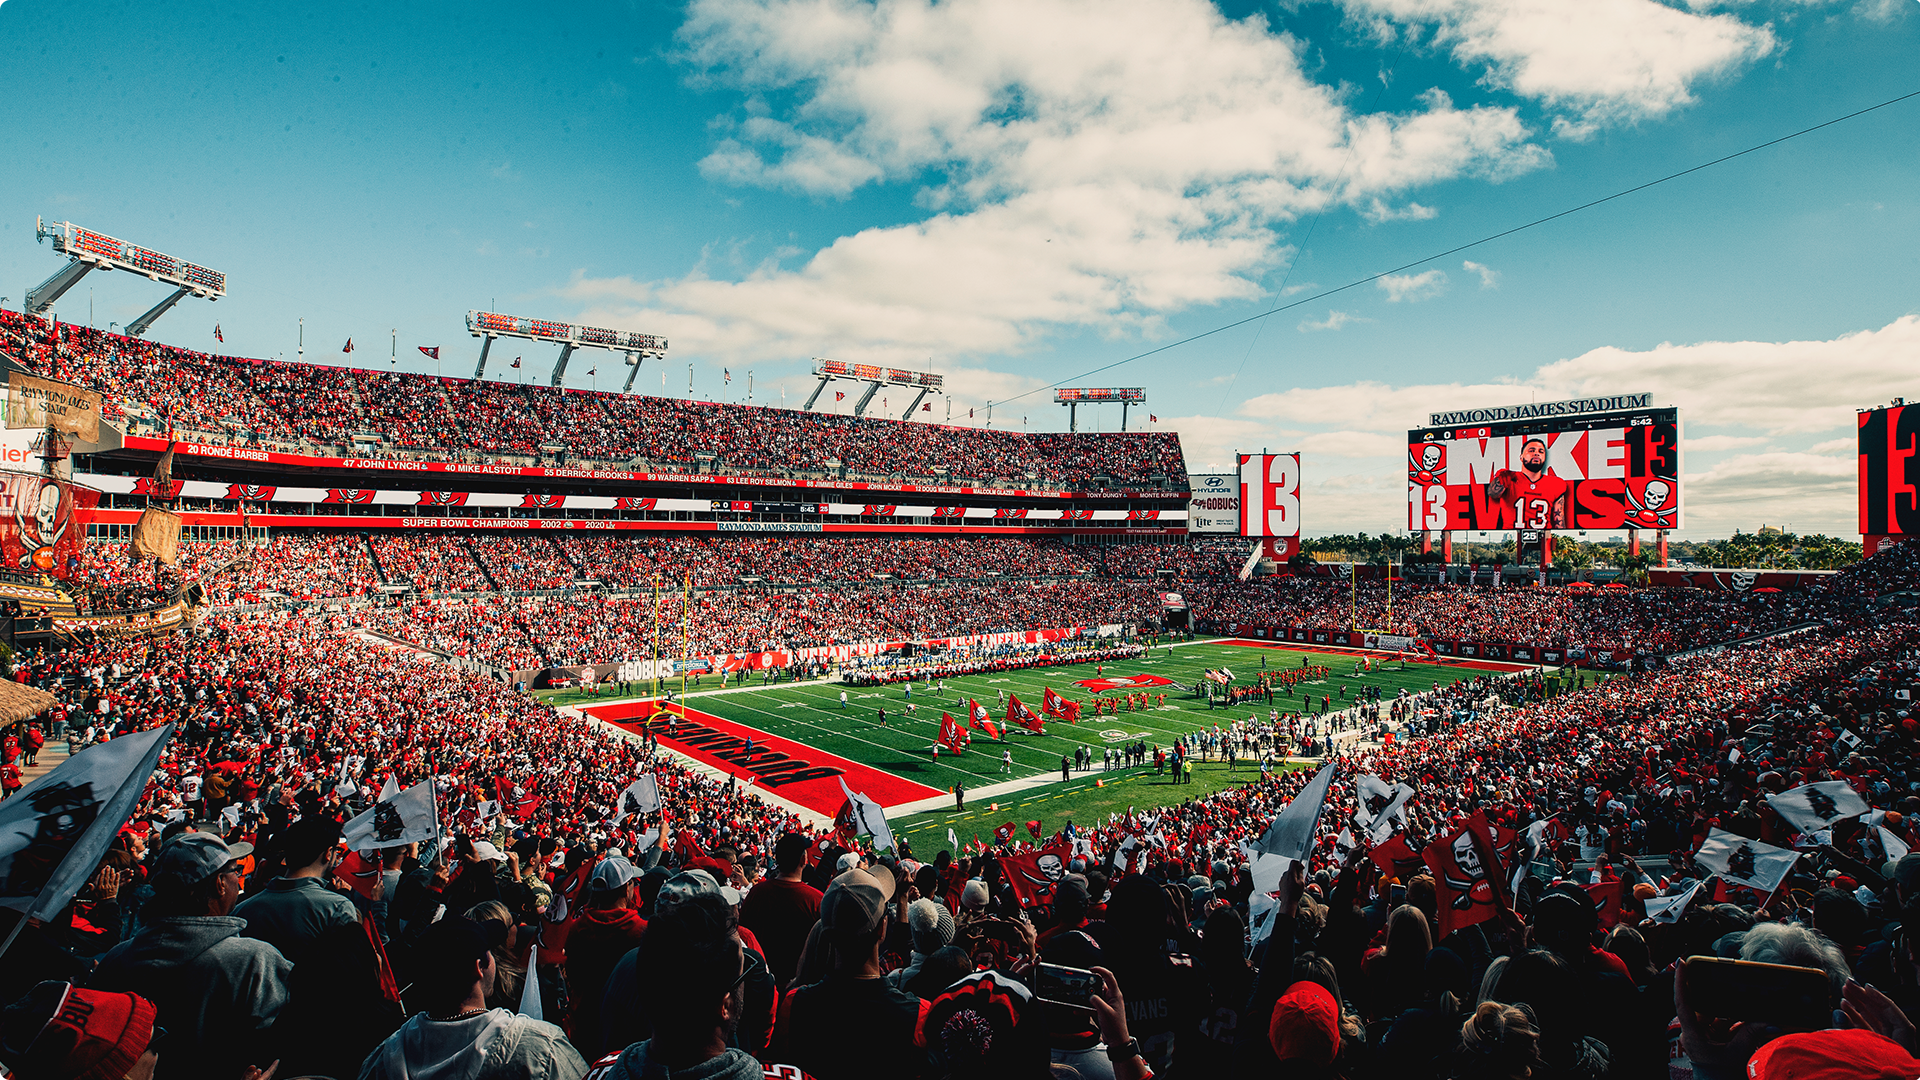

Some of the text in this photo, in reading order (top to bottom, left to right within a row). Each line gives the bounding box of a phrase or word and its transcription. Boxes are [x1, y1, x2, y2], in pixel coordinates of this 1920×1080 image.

[1431, 395, 1647, 425] RAYMOND JAMES STADIUM
[1630, 418, 1653, 426] 5:42
[1443, 430, 1451, 439] 0
[1478, 428, 1486, 437] 0
[188, 444, 199, 454] 20
[234, 450, 269, 461] BARBER
[1446, 424, 1677, 485] MIKE 13
[343, 459, 420, 471] 47 JOHN LYNCH
[445, 464, 522, 475] 40 MIKE ALSTOTT
[556, 469, 592, 478] DERRICK
[594, 471, 628, 480] BROOKS
[657, 474, 689, 482] WARREN
[690, 475, 710, 483] SAPP
[736, 477, 748, 485] LEE
[750, 478, 764, 486] ROY
[765, 478, 792, 487] SELMON
[836, 481, 853, 489] GILES
[997, 488, 1015, 496] GLAZER
[1241, 455, 1299, 536] 13
[1409, 484, 1447, 530] 13
[1513, 497, 1549, 529] 13
[402, 518, 438, 527] SUPER
[440, 518, 470, 528] BOWL
[472, 519, 529, 529] CHAMPIONS
[541, 520, 561, 528] 2002
[585, 521, 605, 529] 2020
[719, 523, 822, 532] RAYMOND JAMES STADIUM
[1196, 517, 1211, 528] Lite
[1523, 531, 1537, 540] 25
[618, 659, 674, 682] #GOBUCS
[185, 782, 197, 793] 12
